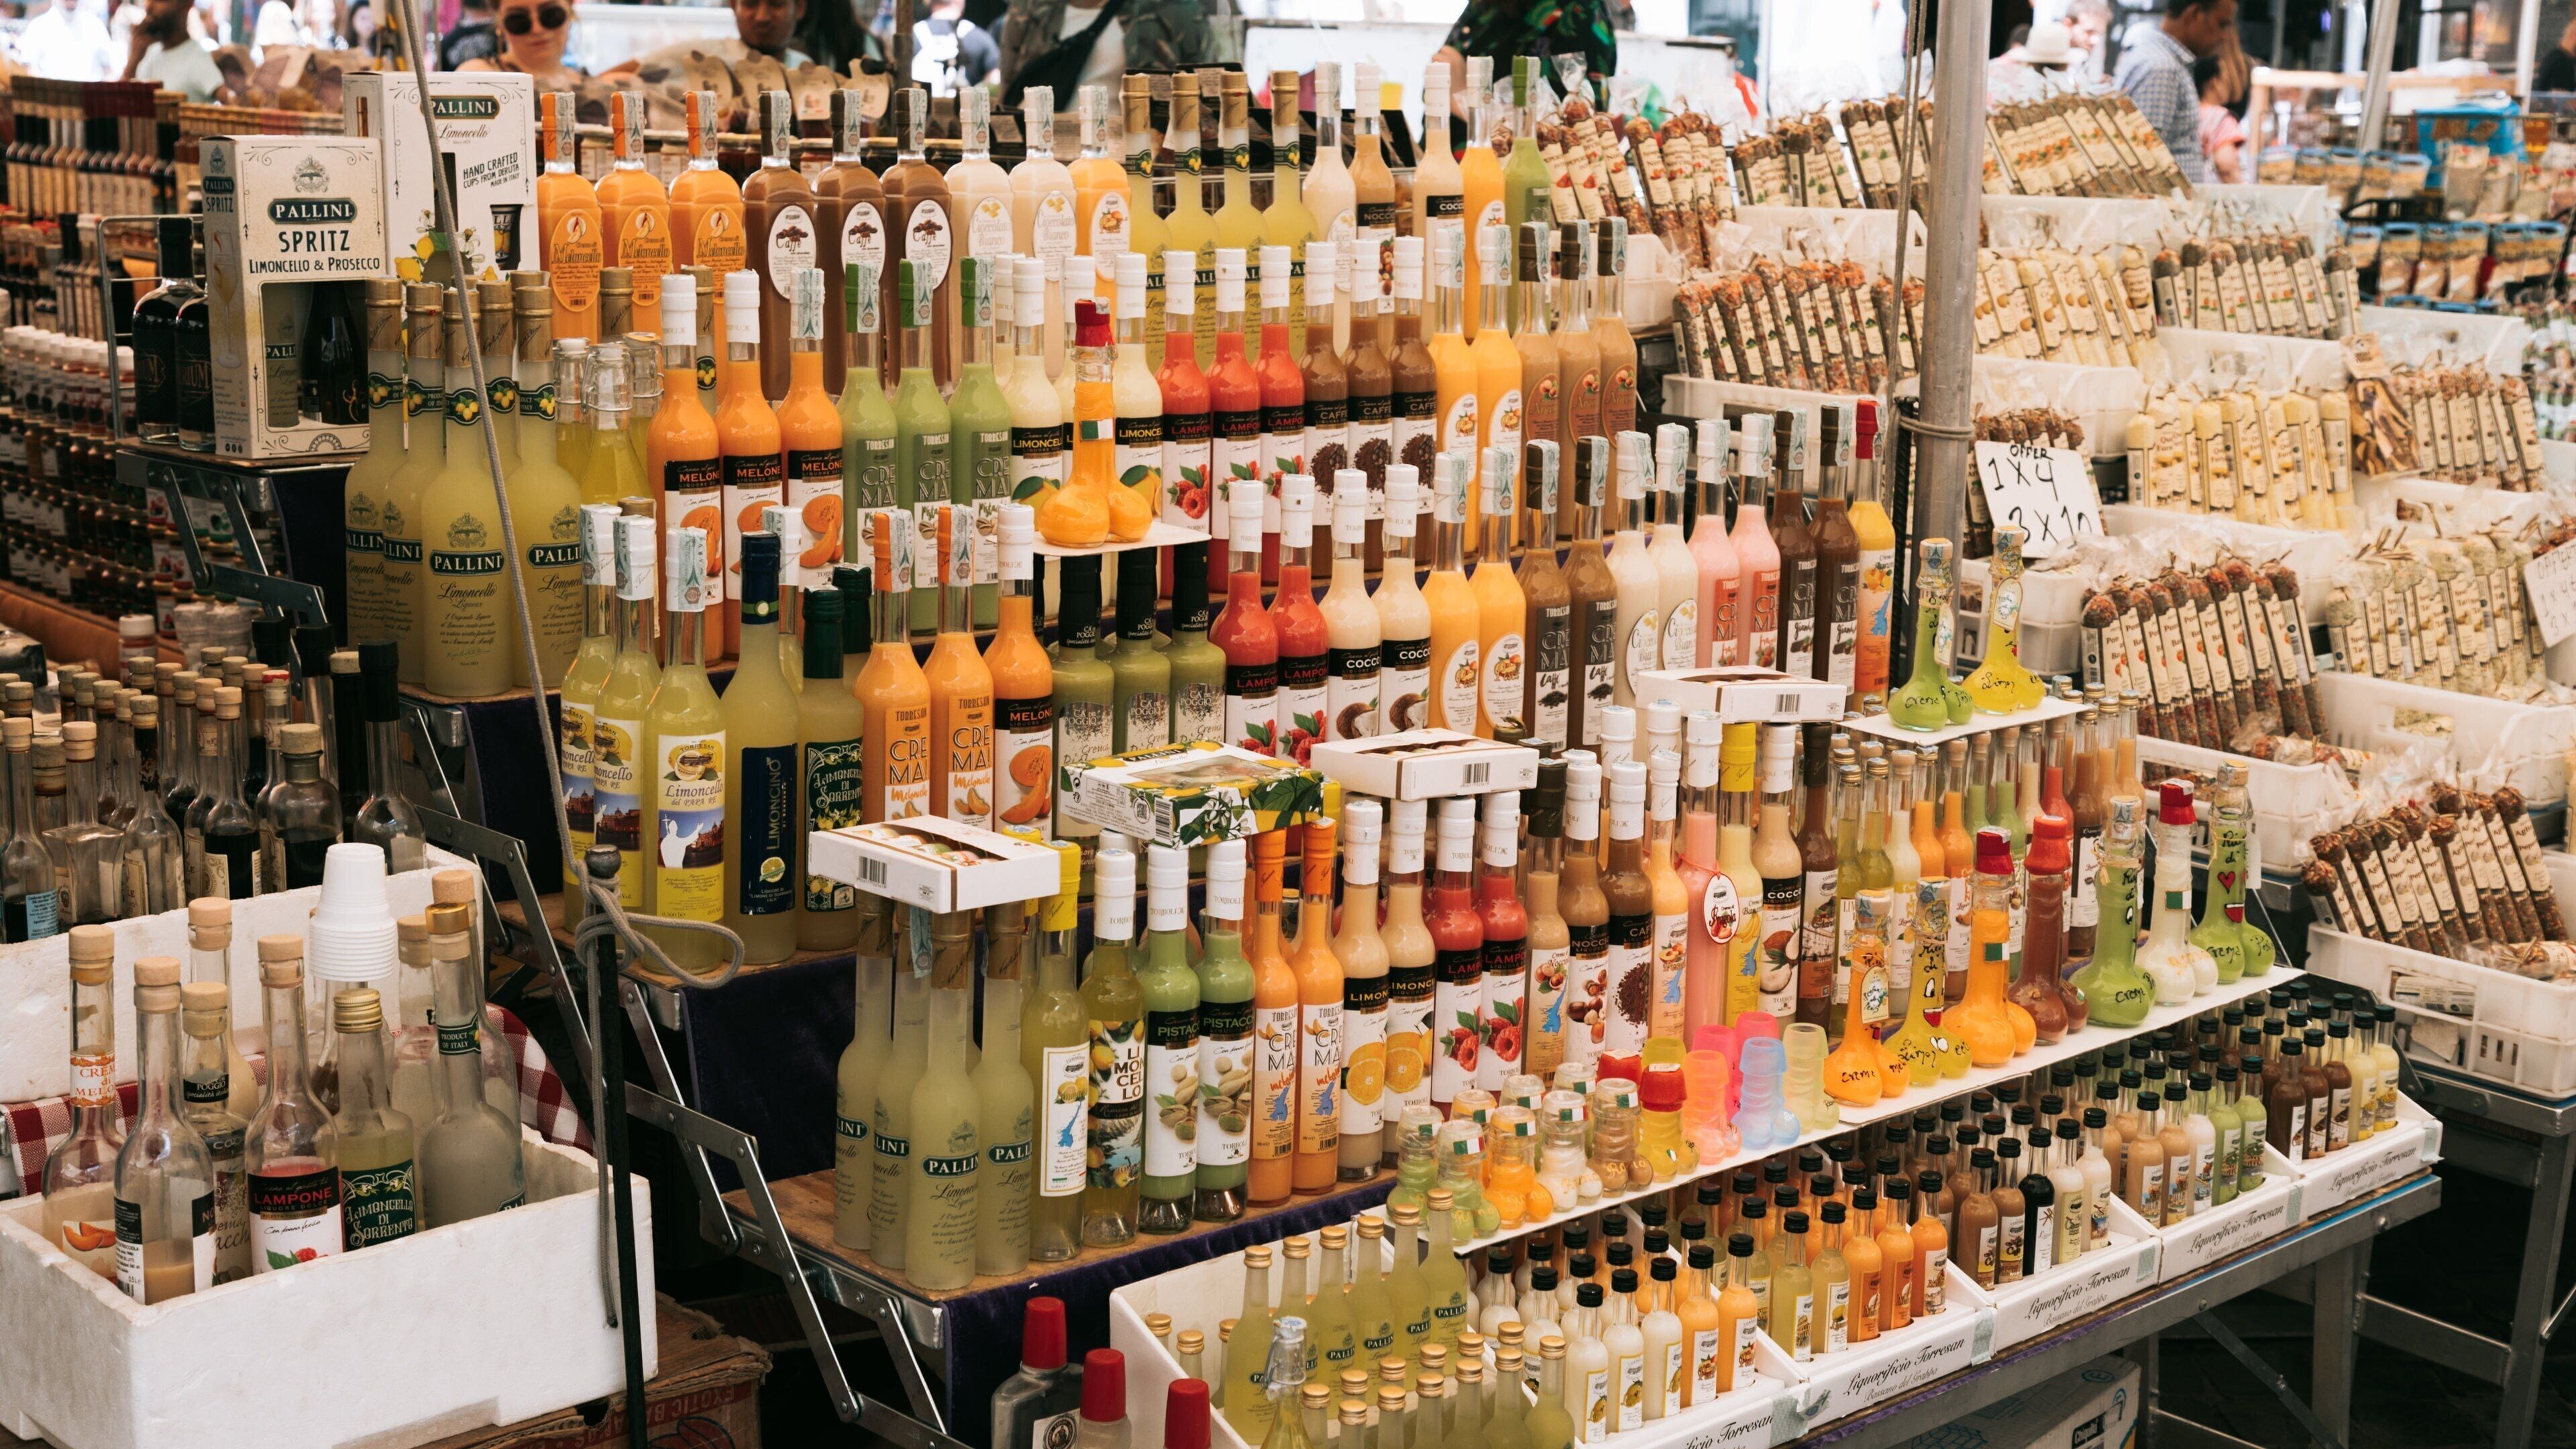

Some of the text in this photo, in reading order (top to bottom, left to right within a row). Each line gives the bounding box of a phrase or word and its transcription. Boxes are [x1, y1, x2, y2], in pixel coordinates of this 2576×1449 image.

[463, 152, 518, 180] HAND CRAFTED
[463, 163, 519, 189] CUPS FROM DERUTA
[490, 178, 502, 188] MADE
[508, 172, 520, 182] ITALY
[207, 197, 233, 213] SPRITZ
[275, 205, 352, 219] PALLINI
[278, 230, 350, 253] SPRITZ
[250, 258, 380, 274] LIMONCELLO & PROSECCO
[737, 466, 781, 477] MELONE
[802, 461, 843, 471] MELONE
[680, 470, 720, 482] MELONE
[435, 555, 501, 570] PALLINI
[437, 582, 497, 603] Limoncello
[1181, 698, 1212, 706] POGGIO
[1010, 708, 1053, 722] MELONE
[1130, 707, 1161, 716] POGGIO
[1065, 716, 1097, 725] POGGIO
[953, 724, 989, 749] CRE
[1148, 733, 1166, 743] Crem
[890, 737, 927, 761] CRE
[813, 768, 862, 788] LIMONCELL
[841, 781, 849, 790] DI
[665, 778, 723, 798] Limoncello
[684, 798, 704, 806] PAPA
[767, 757, 782, 851] LIMONCINO
[1768, 890, 1801, 899] COCCO
[441, 1031, 468, 1041] PRODUCT
[442, 1040, 469, 1050] OF ITALY
[1128, 1048, 1140, 1059] LI
[1122, 1085, 1140, 1099] LO
[254, 1185, 333, 1205] LAMPONE
[345, 1197, 414, 1225] LIMONCELLO
[378, 1213, 389, 1224] DI
[2242, 1203, 2284, 1230] Torresan
[350, 1216, 414, 1247] SORRENTO
[2025, 1265, 2131, 1321] Liquorificio Torresan
[1843, 1338, 1964, 1396] Liquorificio Torresan
